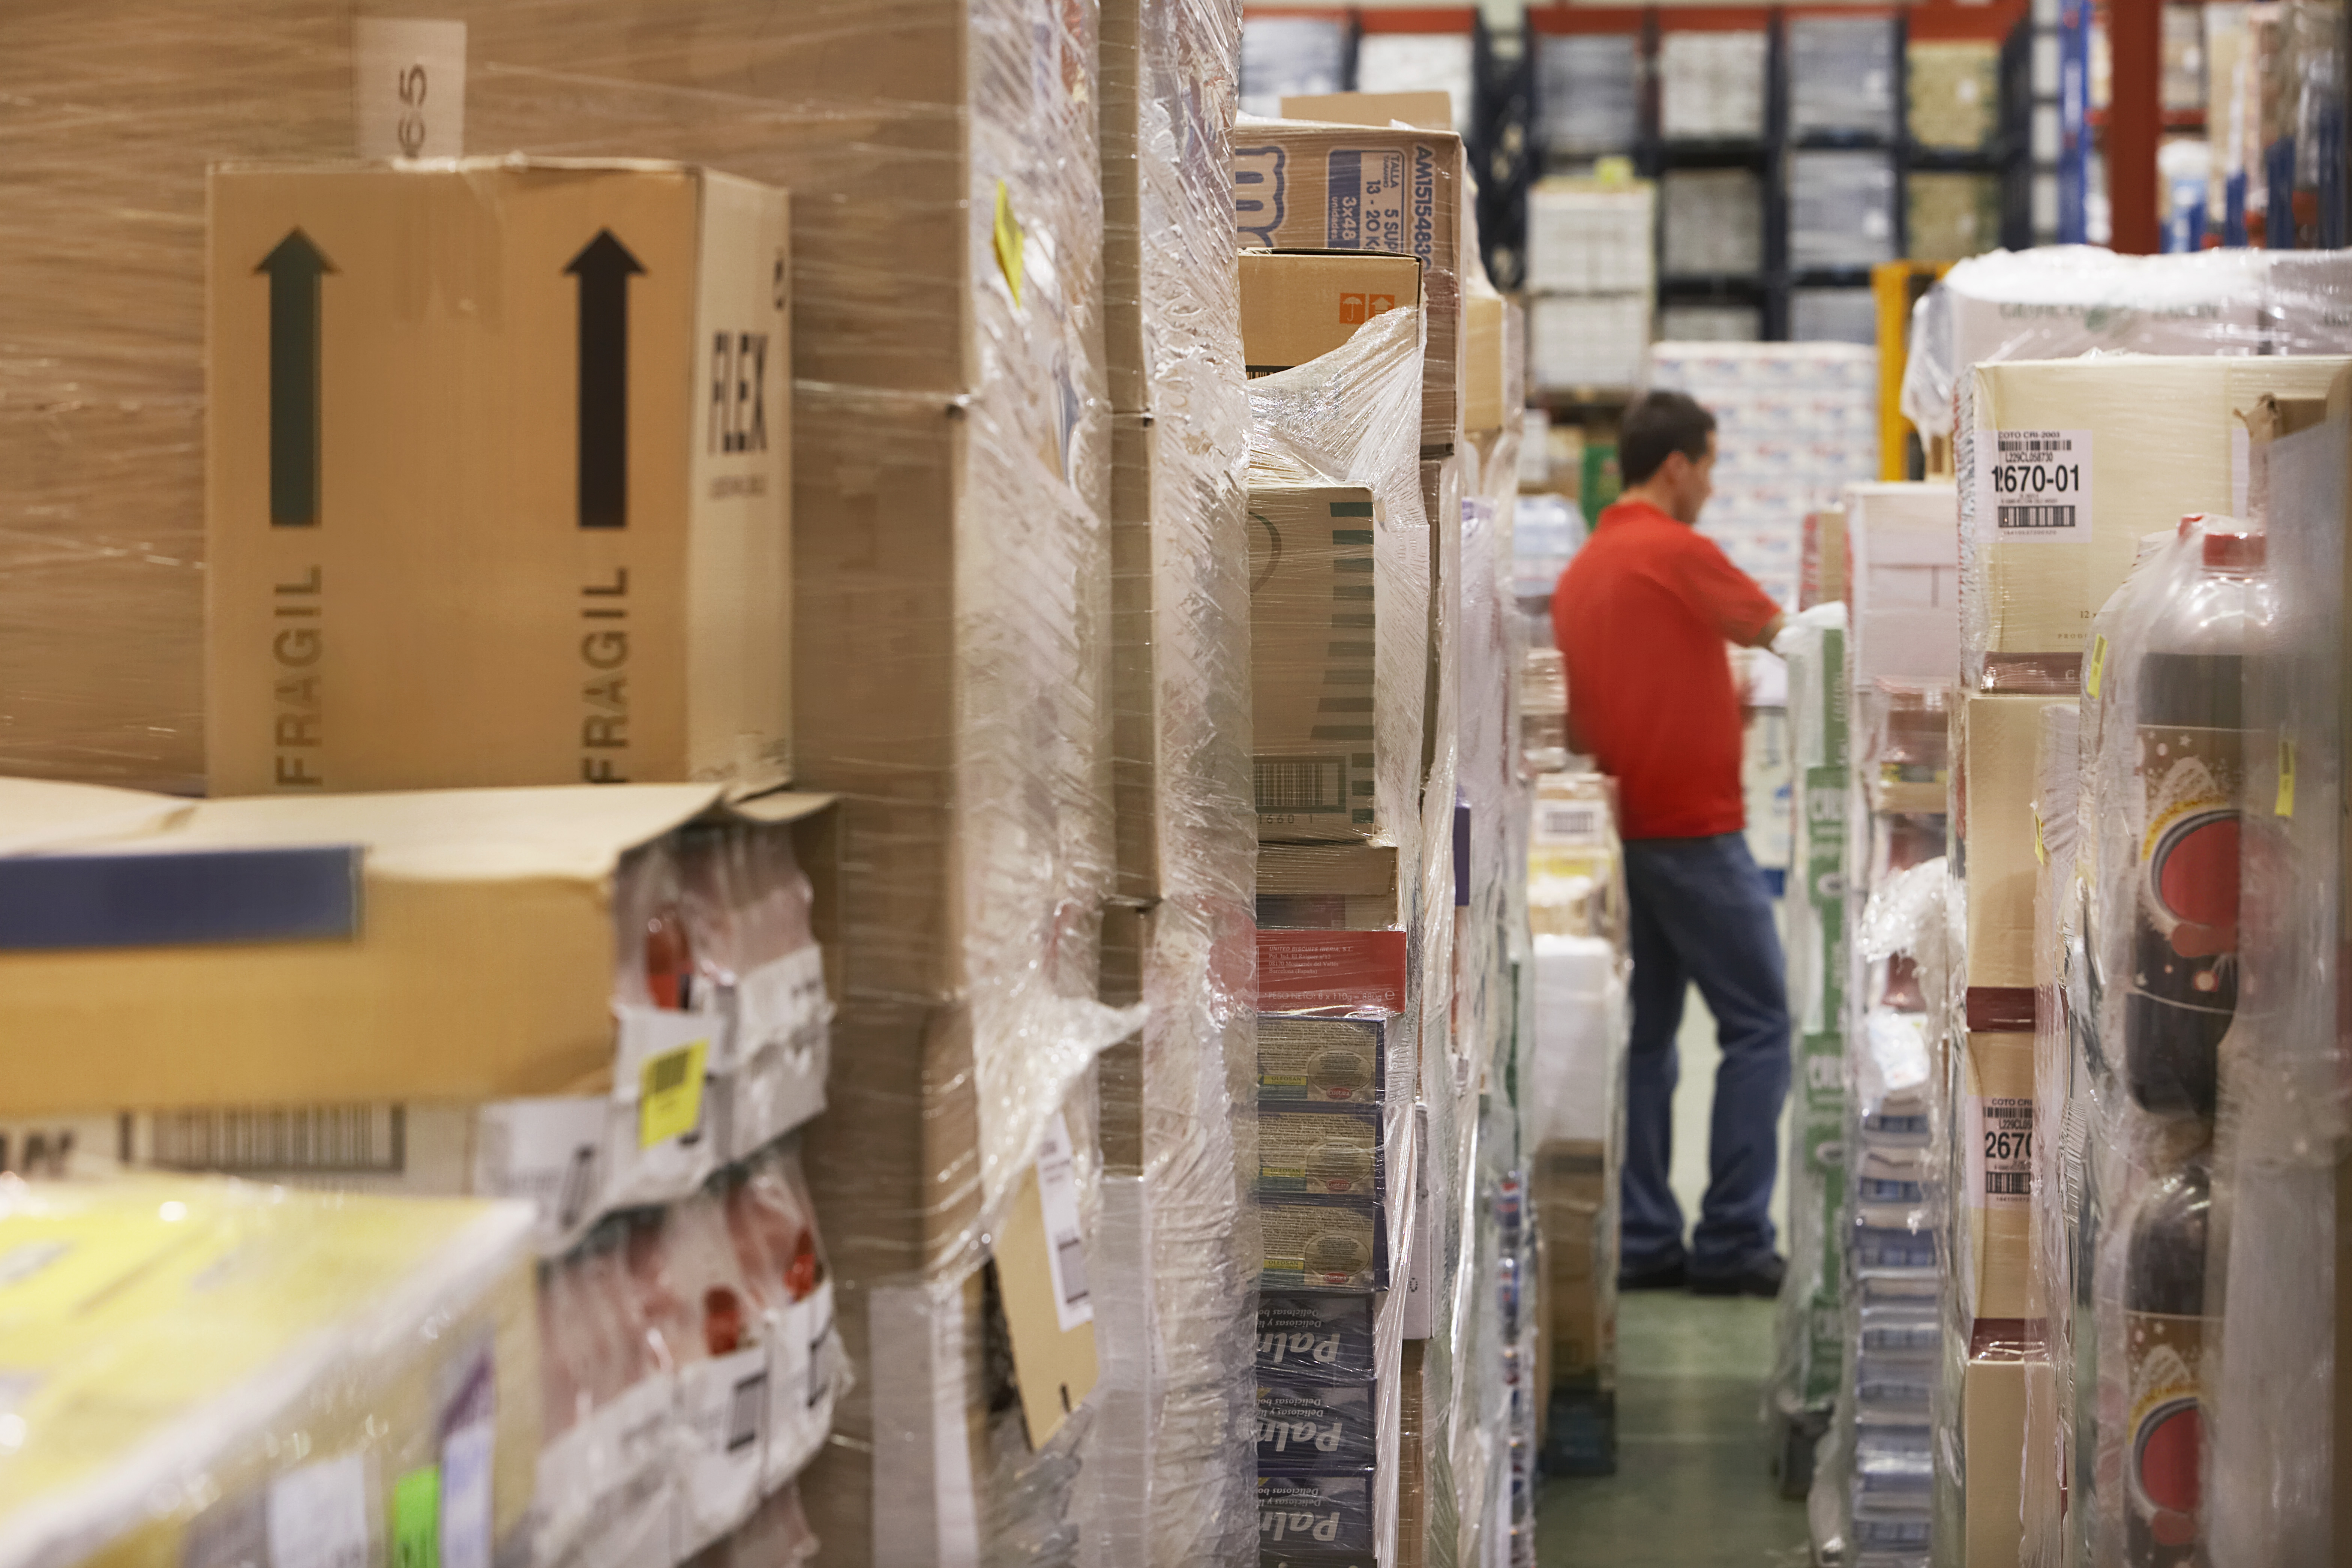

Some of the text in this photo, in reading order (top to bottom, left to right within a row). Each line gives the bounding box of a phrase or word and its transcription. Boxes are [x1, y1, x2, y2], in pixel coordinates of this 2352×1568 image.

[1390, 155, 1400, 188] TALLA
[1366, 179, 1381, 194] 13
[1342, 197, 1357, 240] 3x48
[1365, 210, 1381, 231] 20
[1384, 209, 1399, 218] 5
[1991, 464, 2079, 492] 1670-01
[273, 566, 323, 787] FRAGIL
[578, 566, 630, 784] FRAGIL
[1333, 992, 1352, 1002] 110g
[1362, 993, 1382, 1002] 880g
[1277, 1409, 1324, 1417] Deliciosas
[1267, 1497, 1273, 1505] y
